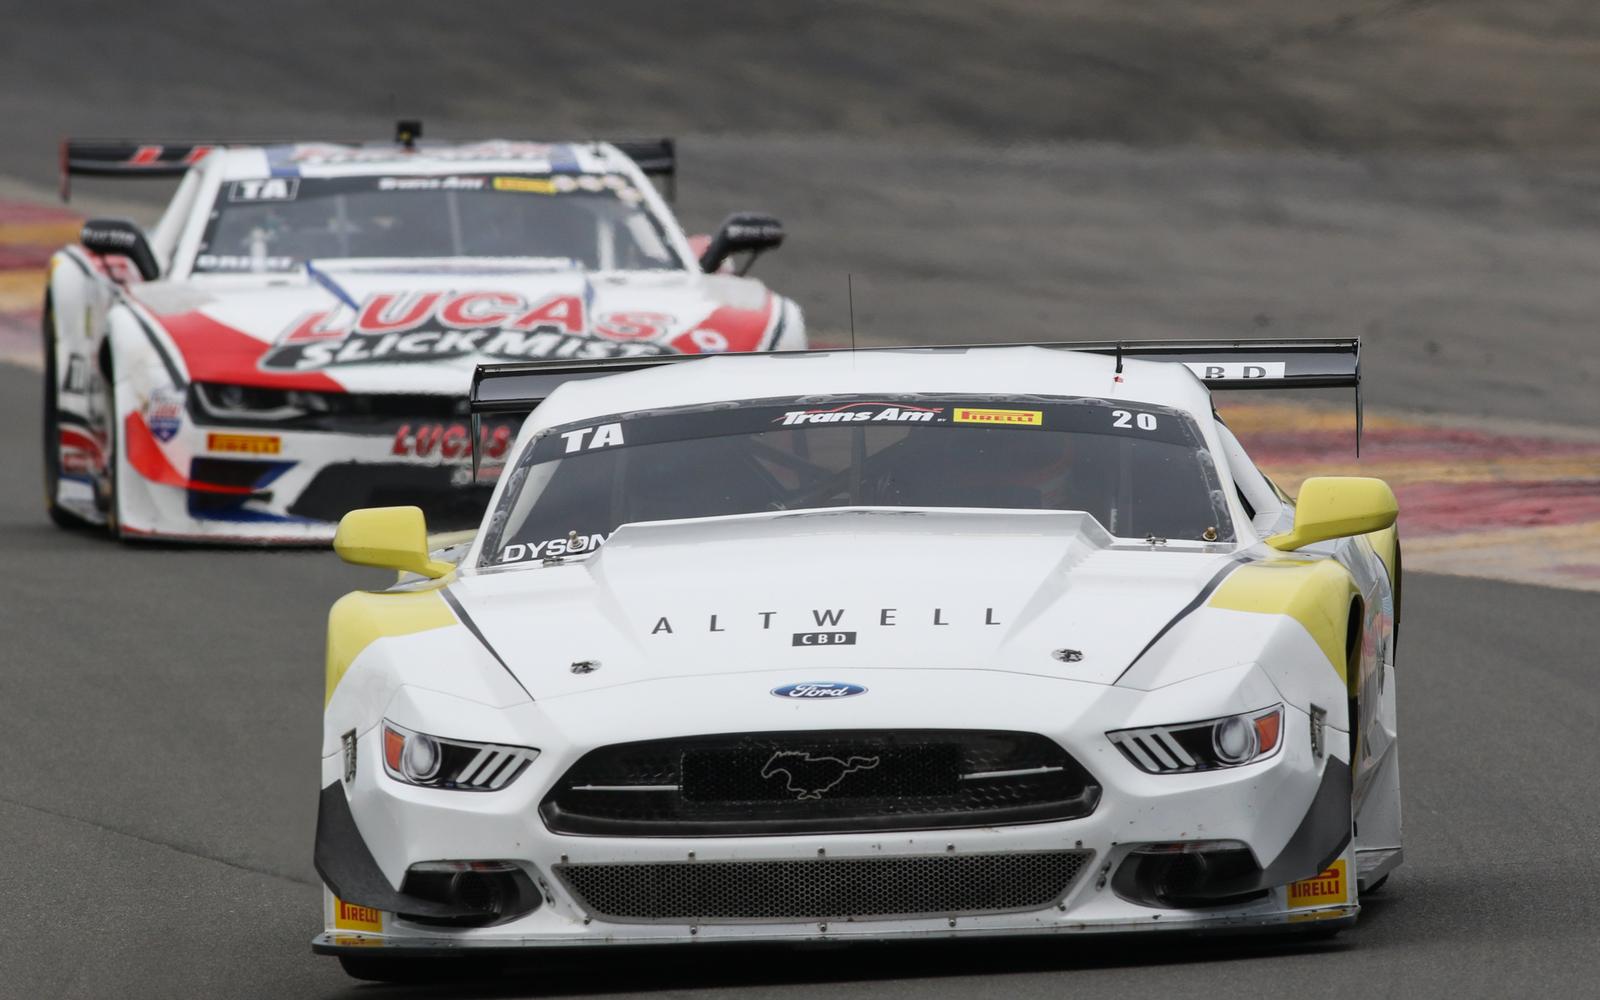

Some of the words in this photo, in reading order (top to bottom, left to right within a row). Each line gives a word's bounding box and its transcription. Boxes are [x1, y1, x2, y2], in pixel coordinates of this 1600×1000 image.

[239, 178, 289, 200] TA
[286, 291, 670, 342] LUCAS
[781, 411, 875, 426] Trans
[871, 407, 935, 423] Am
[961, 410, 1034, 423] PIRELLI
[1112, 409, 1157, 431] 20
[560, 422, 624, 453] TA
[502, 533, 611, 563] DYSON
[801, 633, 847, 645] CBD
[788, 683, 849, 697] Ford
[1290, 869, 1340, 898] PIRELLI
